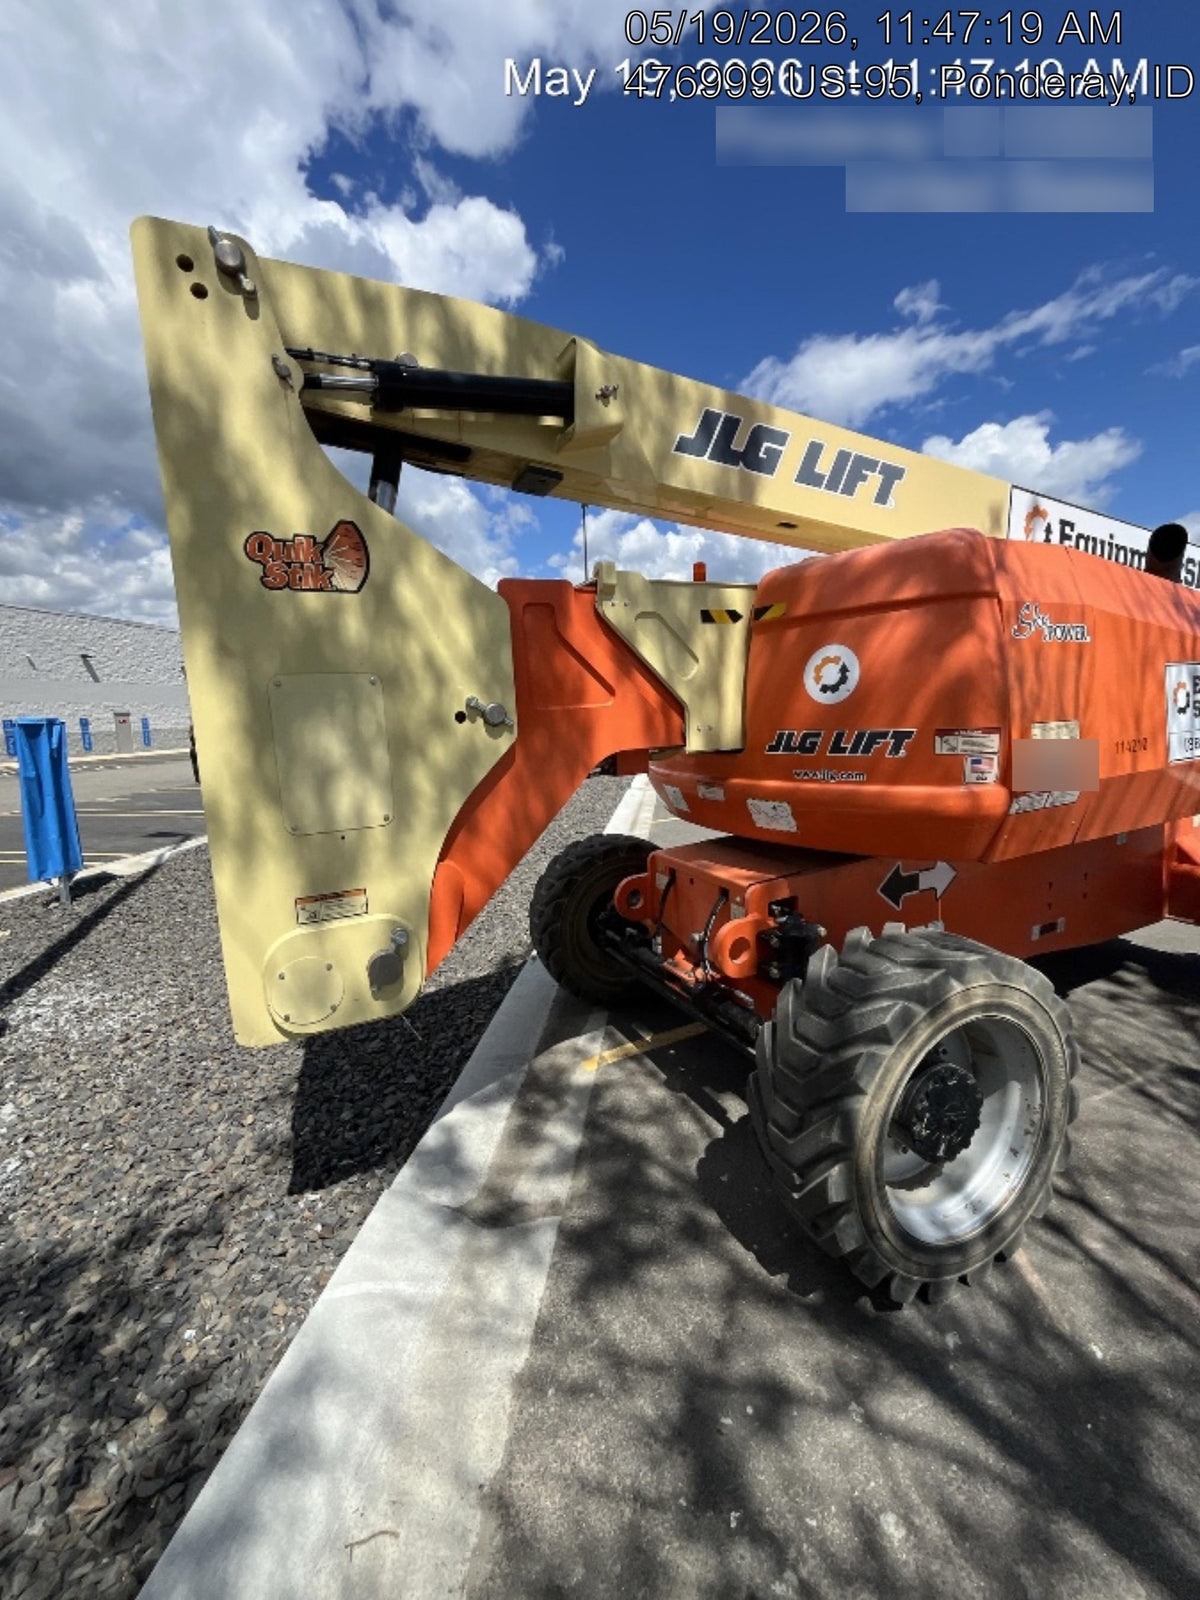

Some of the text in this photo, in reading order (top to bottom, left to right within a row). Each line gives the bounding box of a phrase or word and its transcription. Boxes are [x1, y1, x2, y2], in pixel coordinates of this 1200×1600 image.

[672, 407, 907, 507] JLG LIFT
[245, 532, 325, 564] Quik
[262, 562, 336, 591] Stik
[1043, 624, 1090, 642] POWER
[765, 728, 917, 758] JLG LIFT
[792, 769, 867, 784] www.jlg.com
